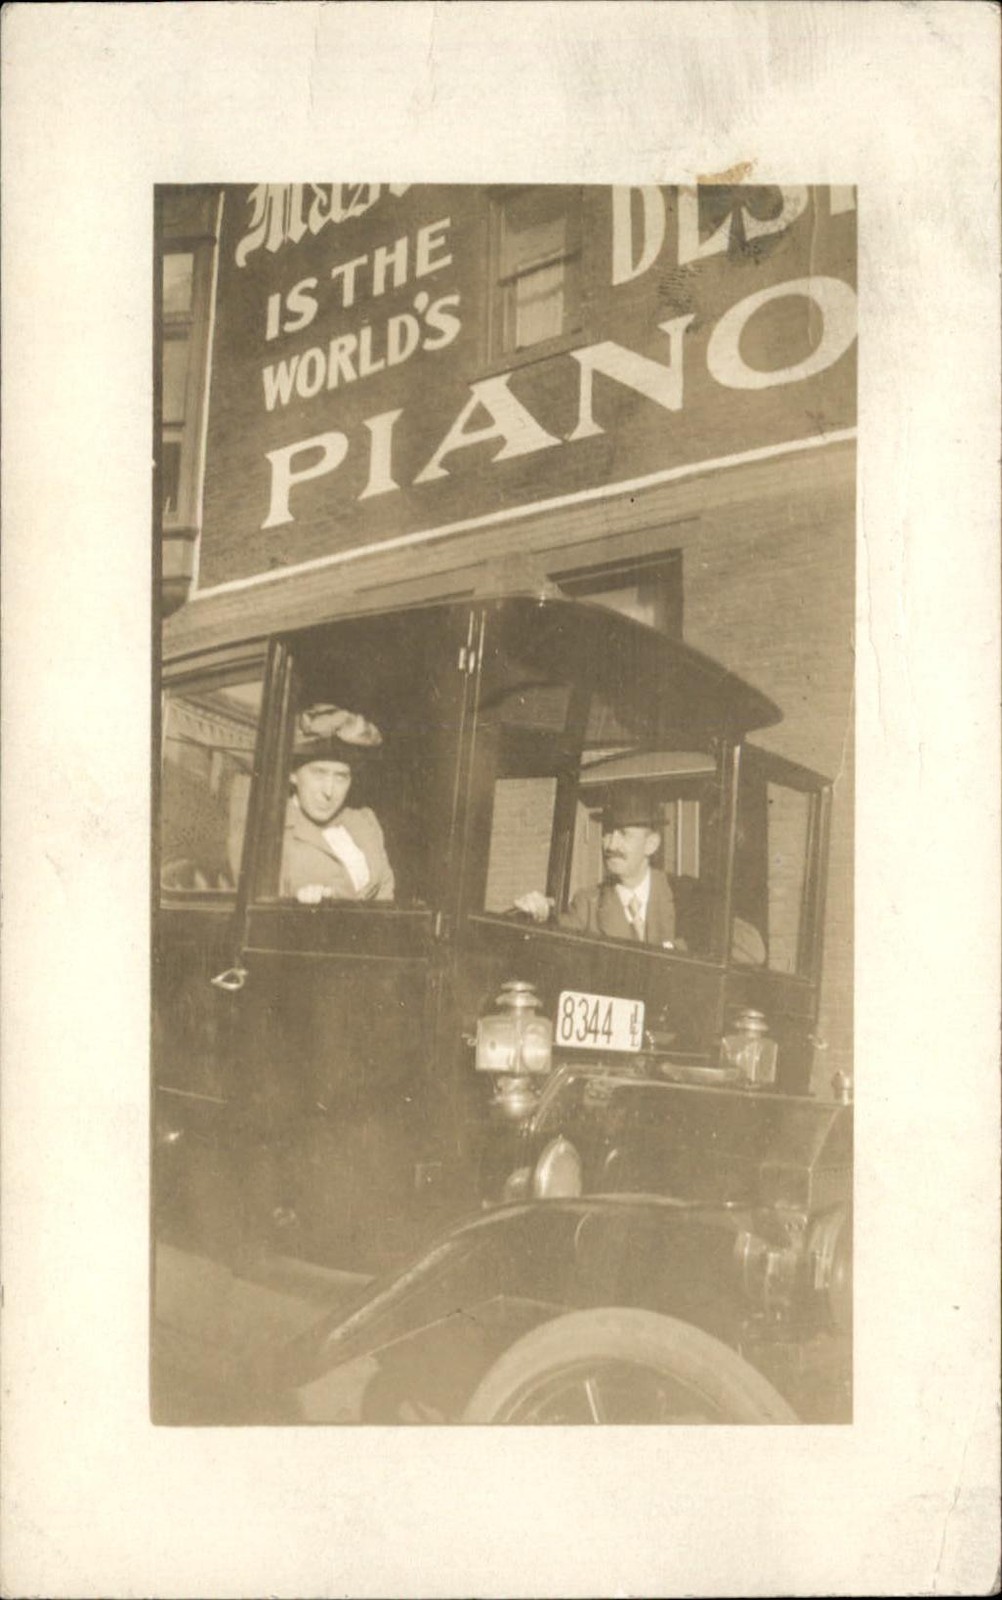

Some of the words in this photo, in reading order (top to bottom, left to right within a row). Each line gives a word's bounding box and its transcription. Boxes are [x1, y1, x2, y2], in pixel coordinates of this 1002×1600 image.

[265, 276, 318, 341] IS
[331, 217, 453, 308] THE
[261, 275, 857, 529] PIANO
[262, 291, 462, 411] WORLD'S
[562, 996, 613, 1044] 8344
